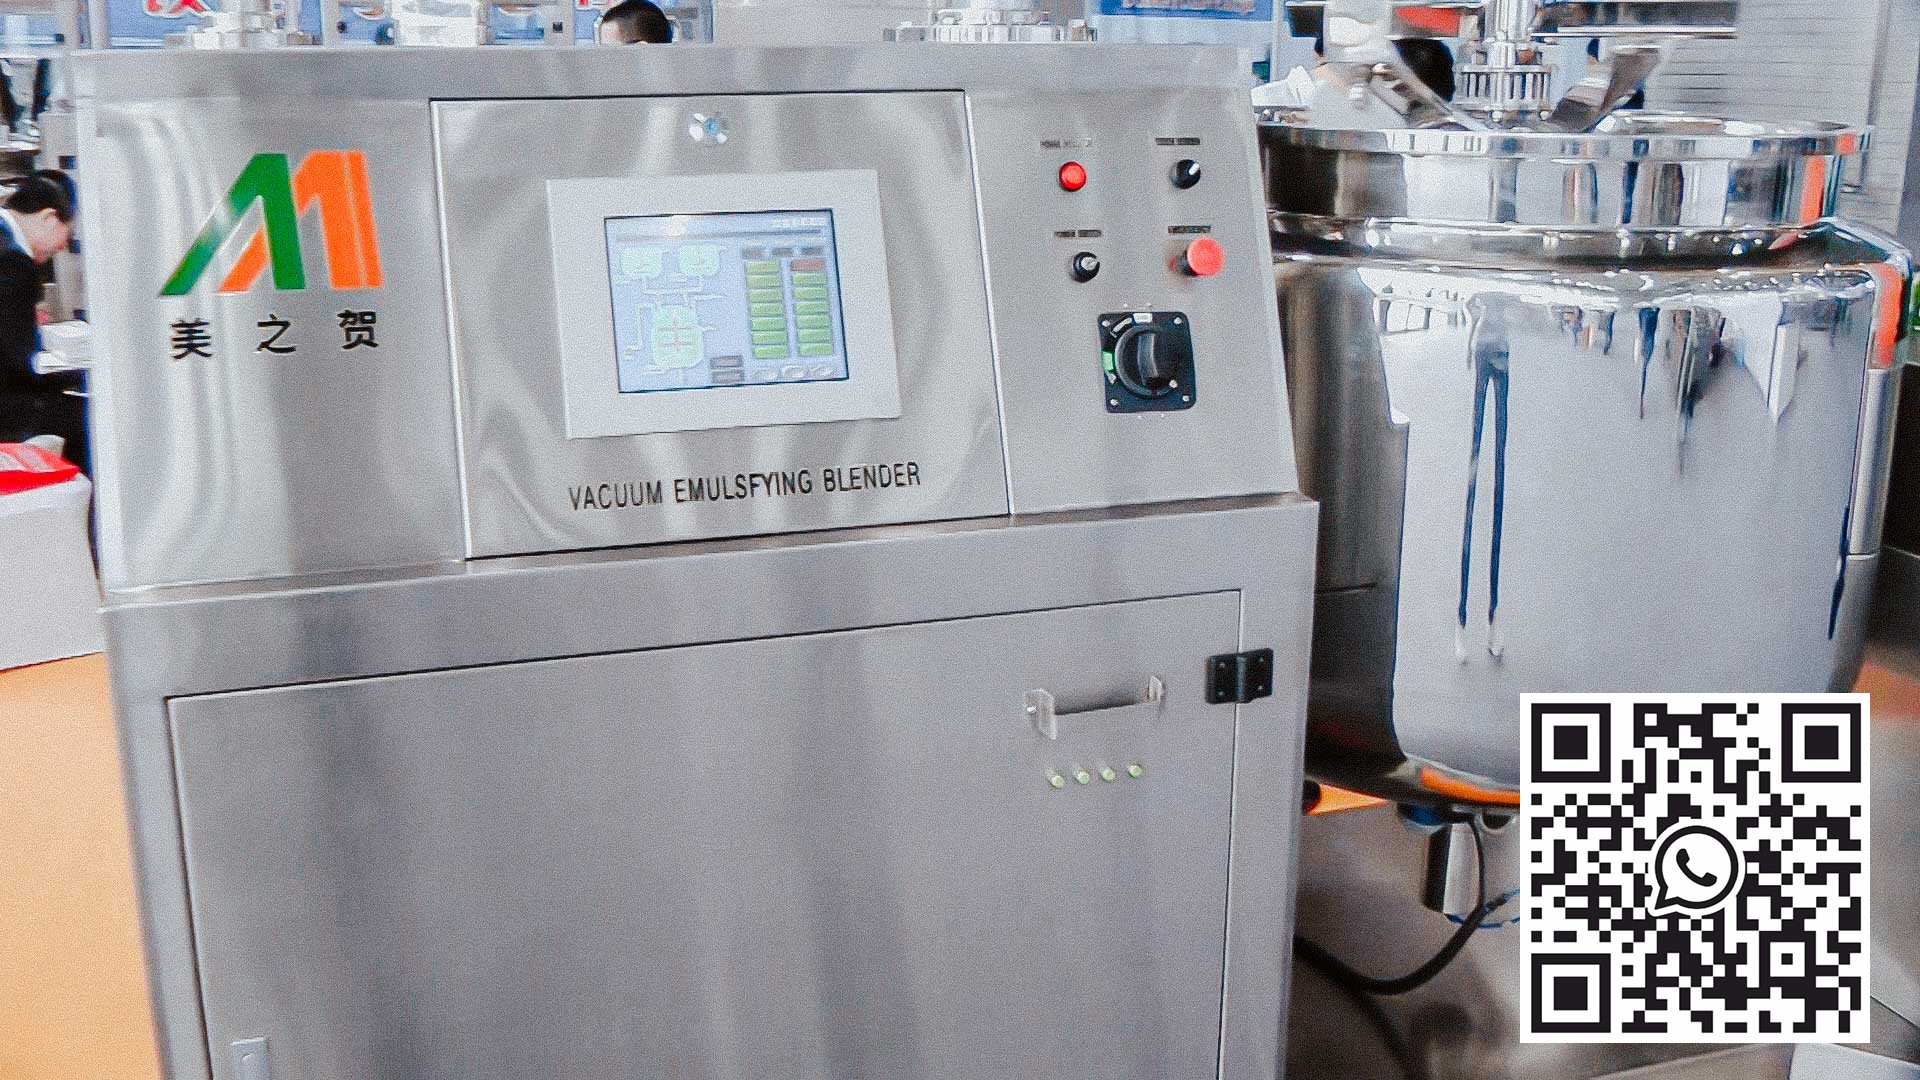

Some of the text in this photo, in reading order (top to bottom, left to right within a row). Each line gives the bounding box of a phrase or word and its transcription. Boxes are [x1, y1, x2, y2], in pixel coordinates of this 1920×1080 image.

[169, 309, 380, 360] 美之贺
[569, 462, 921, 511] VACUUM EMULSFYING BLENDER
